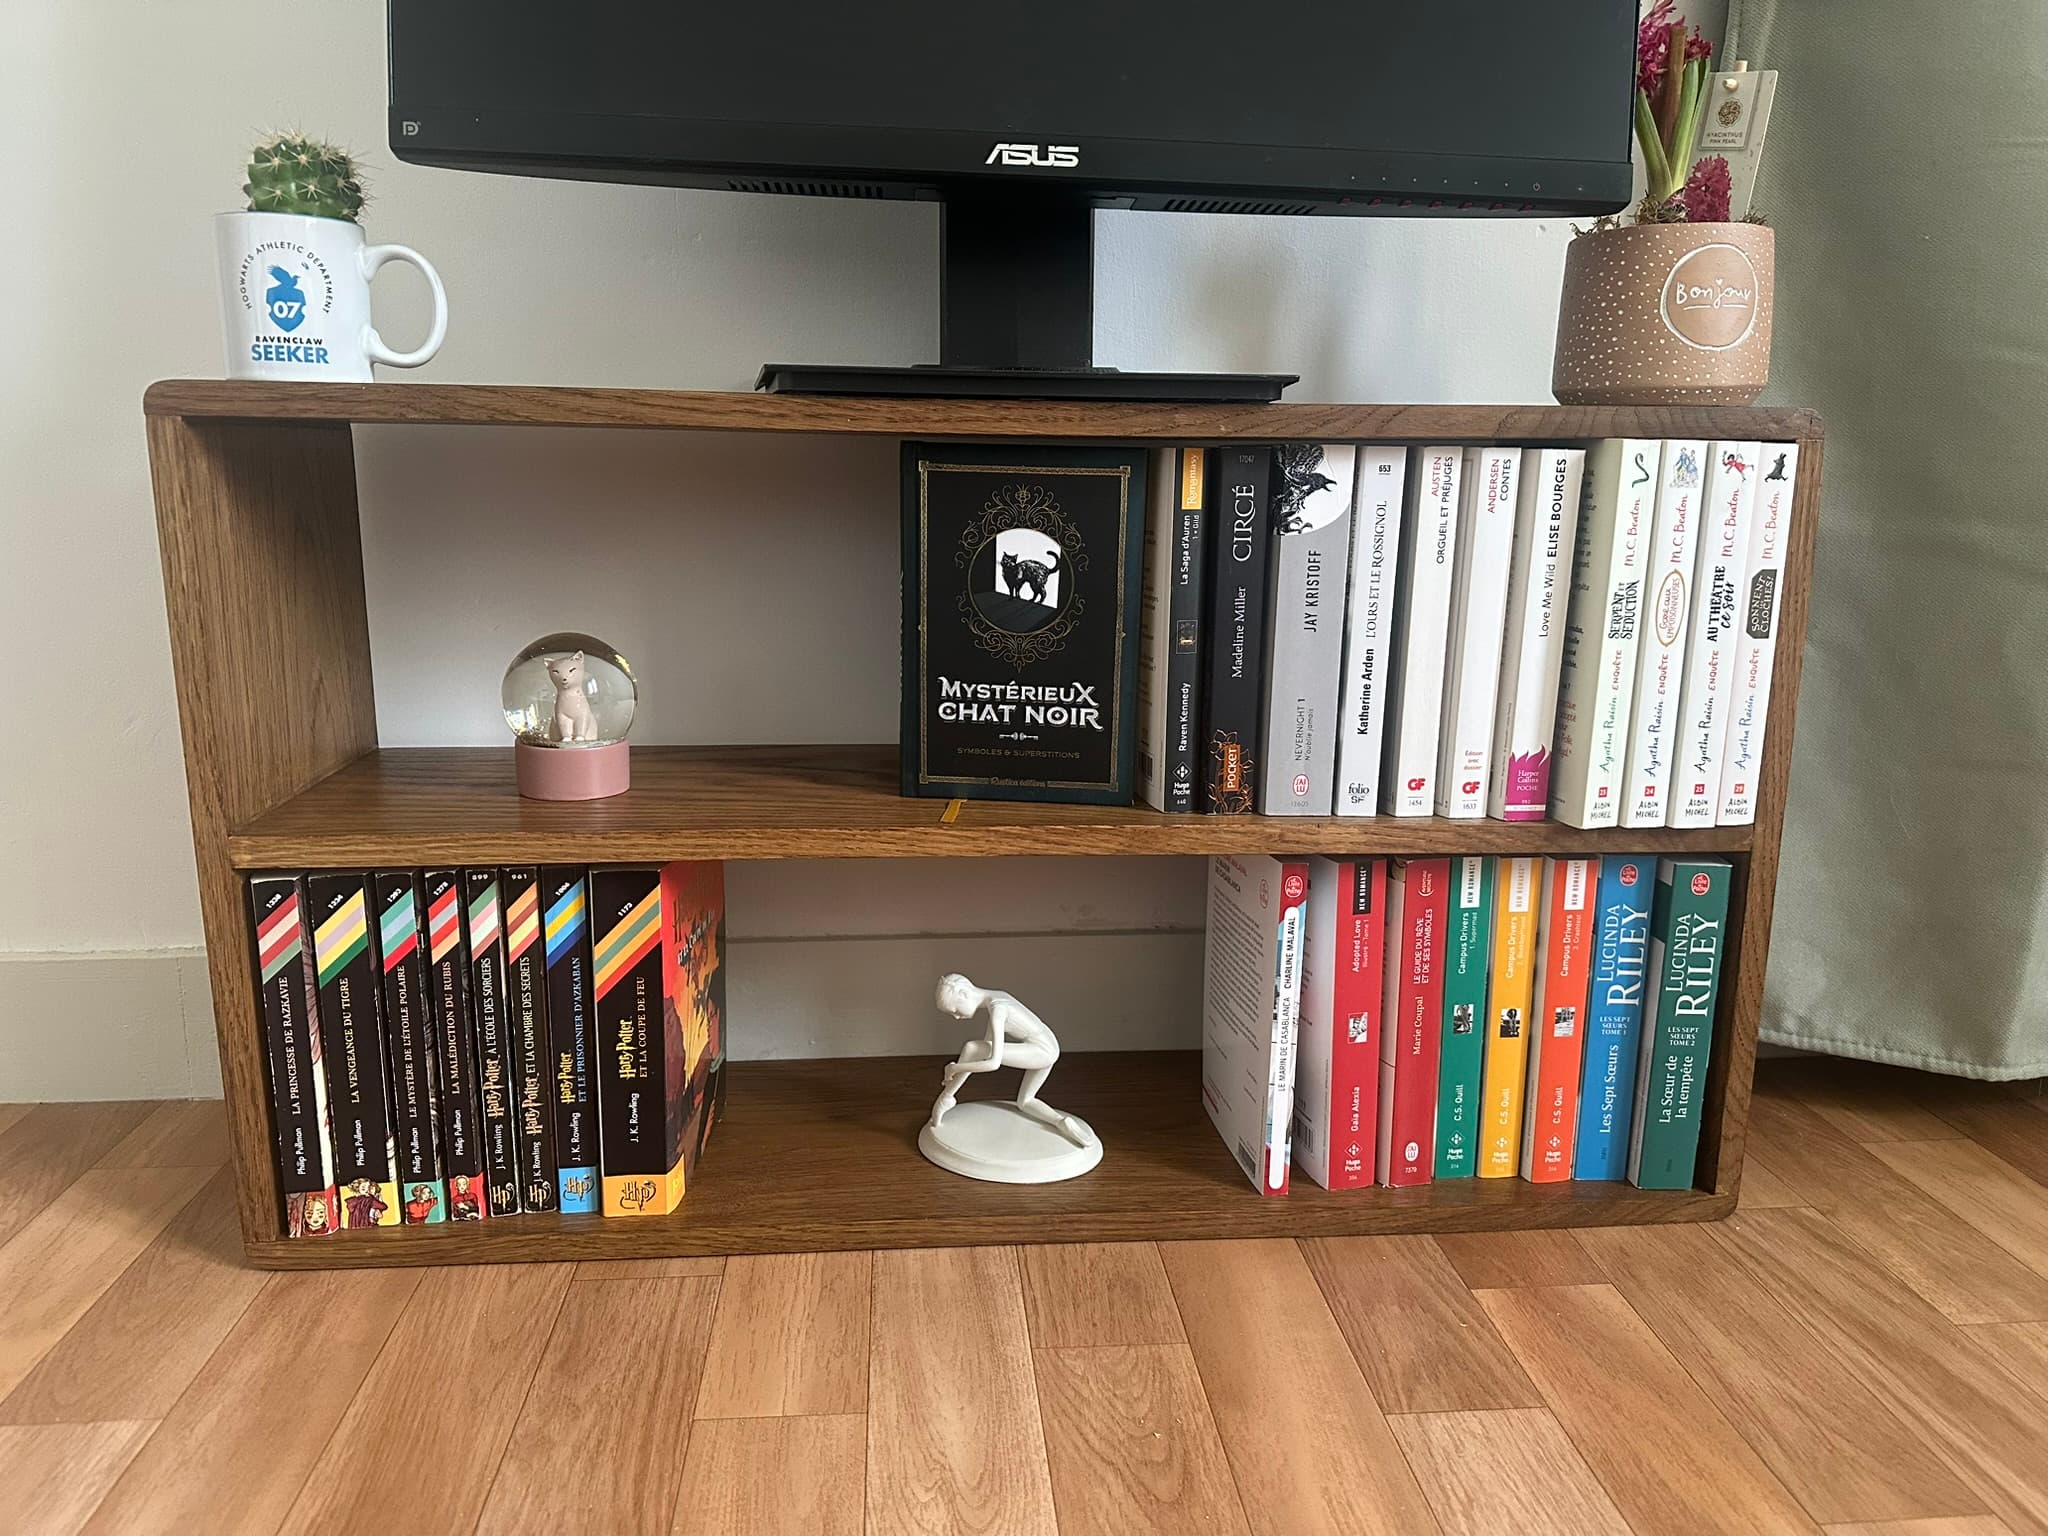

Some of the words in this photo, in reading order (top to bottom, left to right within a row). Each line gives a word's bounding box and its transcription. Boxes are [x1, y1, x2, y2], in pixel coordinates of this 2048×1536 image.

[986, 143, 1080, 167] ASUS
[239, 253, 255, 310] HOGWARTS
[255, 240, 305, 255] ATHLETIC
[306, 251, 334, 314] DEPARTMENT
[273, 300, 302, 319] 07
[251, 343, 330, 364] SEEKER
[255, 335, 323, 346] RAVENCLAW
[1187, 455, 1200, 505] Romantasy
[1378, 464, 1391, 473] 653
[1431, 456, 1442, 497] AUSTEN
[1440, 456, 1453, 503] PRÉJUGÉS
[1499, 458, 1511, 501] CONTES
[1487, 459, 1500, 514] ANDERSEN
[1551, 458, 1567, 521] BOURGES
[1231, 485, 1256, 562] CIRCÉ
[1440, 506, 1449, 518] ET
[1626, 498, 1640, 536] Beaton
[1181, 515, 1192, 549] d'Auren
[1371, 500, 1387, 568] ROSSIGNOL
[1436, 520, 1448, 565] ORGUEIL
[1547, 524, 1560, 558] ELISE
[1180, 550, 1192, 572] Saga
[1180, 577, 1190, 586] La
[1305, 550, 1322, 607] KRISTOFF
[1370, 570, 1381, 584] LE
[1543, 564, 1556, 589] Wild
[1233, 587, 1246, 622] Miller
[1369, 585, 1380, 600] ET
[1541, 591, 1552, 609] Me
[1721, 581, 1735, 611] soir
[1750, 575, 1767, 633] SONNENT
[1760, 575, 1774, 633] CLOCHES!
[1303, 613, 1318, 633] JAY
[1538, 612, 1550, 638] Love
[1608, 591, 1625, 640] SERPENT
[1720, 611, 1731, 629] ce
[1706, 626, 1719, 642] AU
[1231, 635, 1245, 679] Madeline
[1360, 648, 1375, 681] Arden
[1612, 649, 1622, 691] ENQUÊTE
[1179, 682, 1192, 722] Kennedy
[1356, 684, 1372, 736] Katherine
[1602, 696, 1617, 729] Raisin
[938, 702, 1017, 726] CHAT
[1024, 703, 1104, 733] NOIR
[1177, 724, 1188, 753] Raven
[1295, 707, 1306, 761] NEVERNIGHT
[957, 747, 1002, 758] SYMBOLES
[1014, 750, 1081, 760] SUPERSTITIONS
[1599, 732, 1614, 774] Agatha
[1407, 778, 1426, 791] GF
[1517, 769, 1539, 778] Harper
[1348, 782, 1370, 794] folio
[1462, 781, 1481, 794] GF
[1590, 810, 1611, 820] MICHEL
[1593, 801, 1610, 810] ALBIN
[618, 902, 633, 917] 1173
[1286, 916, 1296, 952] MALAVAL
[1353, 919, 1361, 939] Love
[1415, 917, 1424, 938] RÊVE
[1424, 909, 1433, 947] SYMBOLES
[1459, 912, 1470, 942] Drivers
[1352, 939, 1362, 972] Adopted
[1415, 938, 1423, 950] DU
[1423, 947, 1431, 962] SES
[1597, 904, 1621, 981] LUCINDA
[1605, 903, 1649, 1006] RILEY
[1665, 912, 1691, 993] LUCINDA
[1283, 953, 1293, 989] CHARLINE
[1413, 950, 1422, 975] GUIDE
[1422, 962, 1429, 973] DE
[1458, 943, 1468, 975] Campus
[1674, 912, 1719, 1017] RILEY
[396, 965, 408, 1005] POLAIRE
[441, 961, 452, 991] RUBIS
[520, 956, 531, 992] SECRETS
[571, 957, 583, 1012] D'AZKABAN
[636, 977, 646, 996] FEU
[1413, 975, 1420, 985] LE
[1422, 975, 1429, 984] ET
[278, 976, 292, 1027] RAZKAVIE
[339, 977, 350, 1010] TIGRE
[444, 991, 454, 1008] DU
[521, 992, 532, 1009] DES
[638, 998, 646, 1012] DE
[342, 1012, 353, 1027] DU
[1280, 997, 1290, 1044] CASABLANCA
[1415, 996, 1424, 1028] Coupal
[284, 1029, 294, 1044] DE
[399, 1006, 411, 1045] L'ÉTOILE
[522, 1009, 534, 1050] CHAMBRE
[638, 1014, 647, 1048] COUPE
[402, 1047, 412, 1060] DE
[445, 1012, 459, 1080] MALÉDICTION
[574, 1014, 586, 1073] PRISONNIER
[1279, 1046, 1288, 1056] DE
[1412, 1029, 1422, 1055] Marie
[344, 1028, 358, 1089] VENGEANCE
[526, 1050, 536, 1062] LA
[527, 1064, 536, 1073] ET
[558, 1049, 576, 1081] Potter
[639, 1049, 647, 1062] LA
[1604, 1045, 1619, 1083] Sœurs
[1664, 1056, 1677, 1070] de
[286, 1046, 300, 1100] PRINCESSE
[404, 1062, 416, 1103] MYSTÈRE
[577, 1075, 586, 1087] LE
[640, 1066, 648, 1078] ET
[1278, 1058, 1288, 1081] MARIN
[1677, 1055, 1693, 1105] tempête
[350, 1090, 360, 1104] LA
[450, 1081, 460, 1095] LA
[521, 1073, 544, 1108] Potter
[560, 1080, 576, 1104] Harry
[578, 1091, 587, 1103] ET
[1278, 1083, 1286, 1092] LE
[1350, 1086, 1361, 1111] Alexia
[1454, 1084, 1463, 1104] Quill
[1601, 1085, 1615, 1111] Sept
[1661, 1072, 1675, 1106] Sœur
[290, 1102, 301, 1115] LA
[408, 1106, 418, 1119] LE
[525, 1107, 543, 1136] Harry
[1454, 1104, 1462, 1121] C.S.
[1658, 1110, 1671, 1123] La
[1674, 1107, 1687, 1118] la
[1350, 1112, 1360, 1132] Gaia
[1599, 1113, 1611, 1134] Les
[293, 1127, 305, 1155] Pullman
[294, 1155, 307, 1175] Philip
[532, 1141, 541, 1169] Rowling
